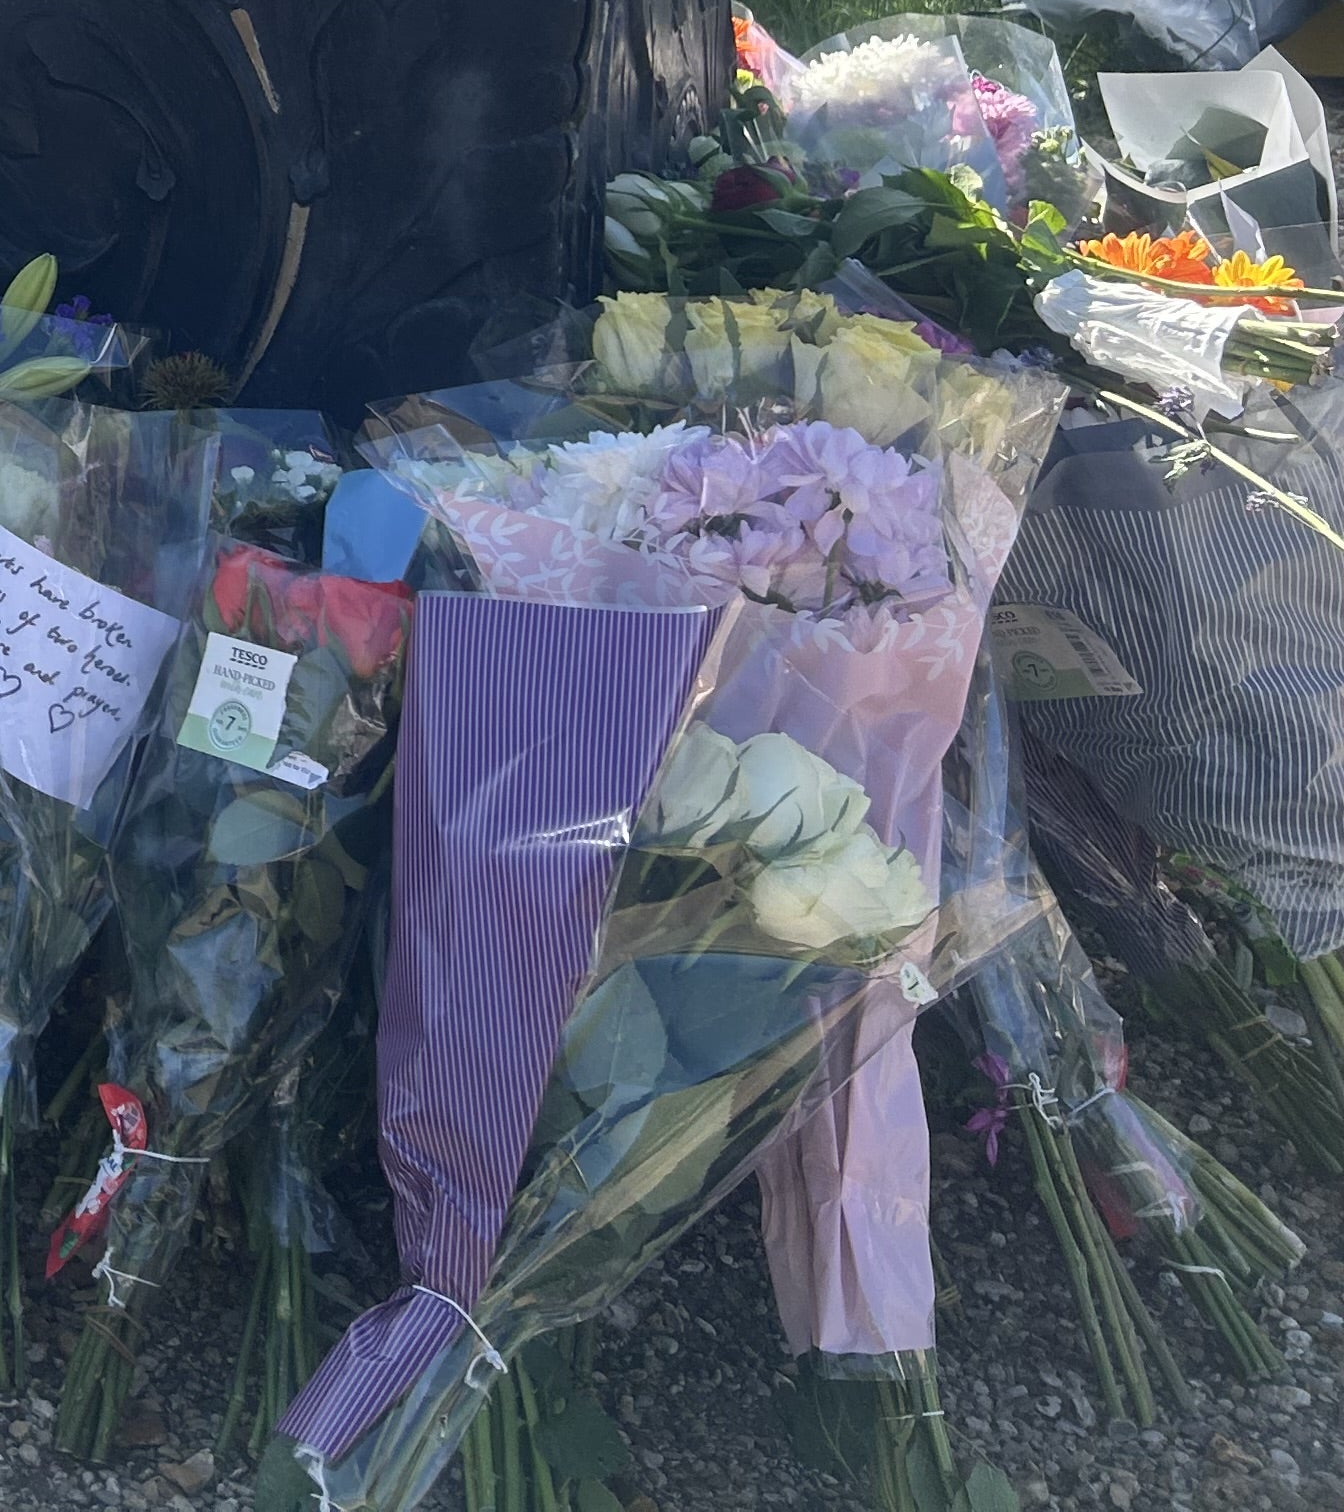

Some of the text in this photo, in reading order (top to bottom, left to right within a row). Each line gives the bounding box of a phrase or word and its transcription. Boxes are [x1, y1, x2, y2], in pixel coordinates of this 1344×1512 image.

[30, 575, 70, 610] have
[78, 600, 133, 648] broken
[5, 610, 41, 635] of
[46, 625, 78, 653] two
[231, 646, 268, 666] TESCO
[23, 662, 61, 685] and
[213, 664, 276, 692] HAND-PICKED
[225, 714, 237, 730] 7
